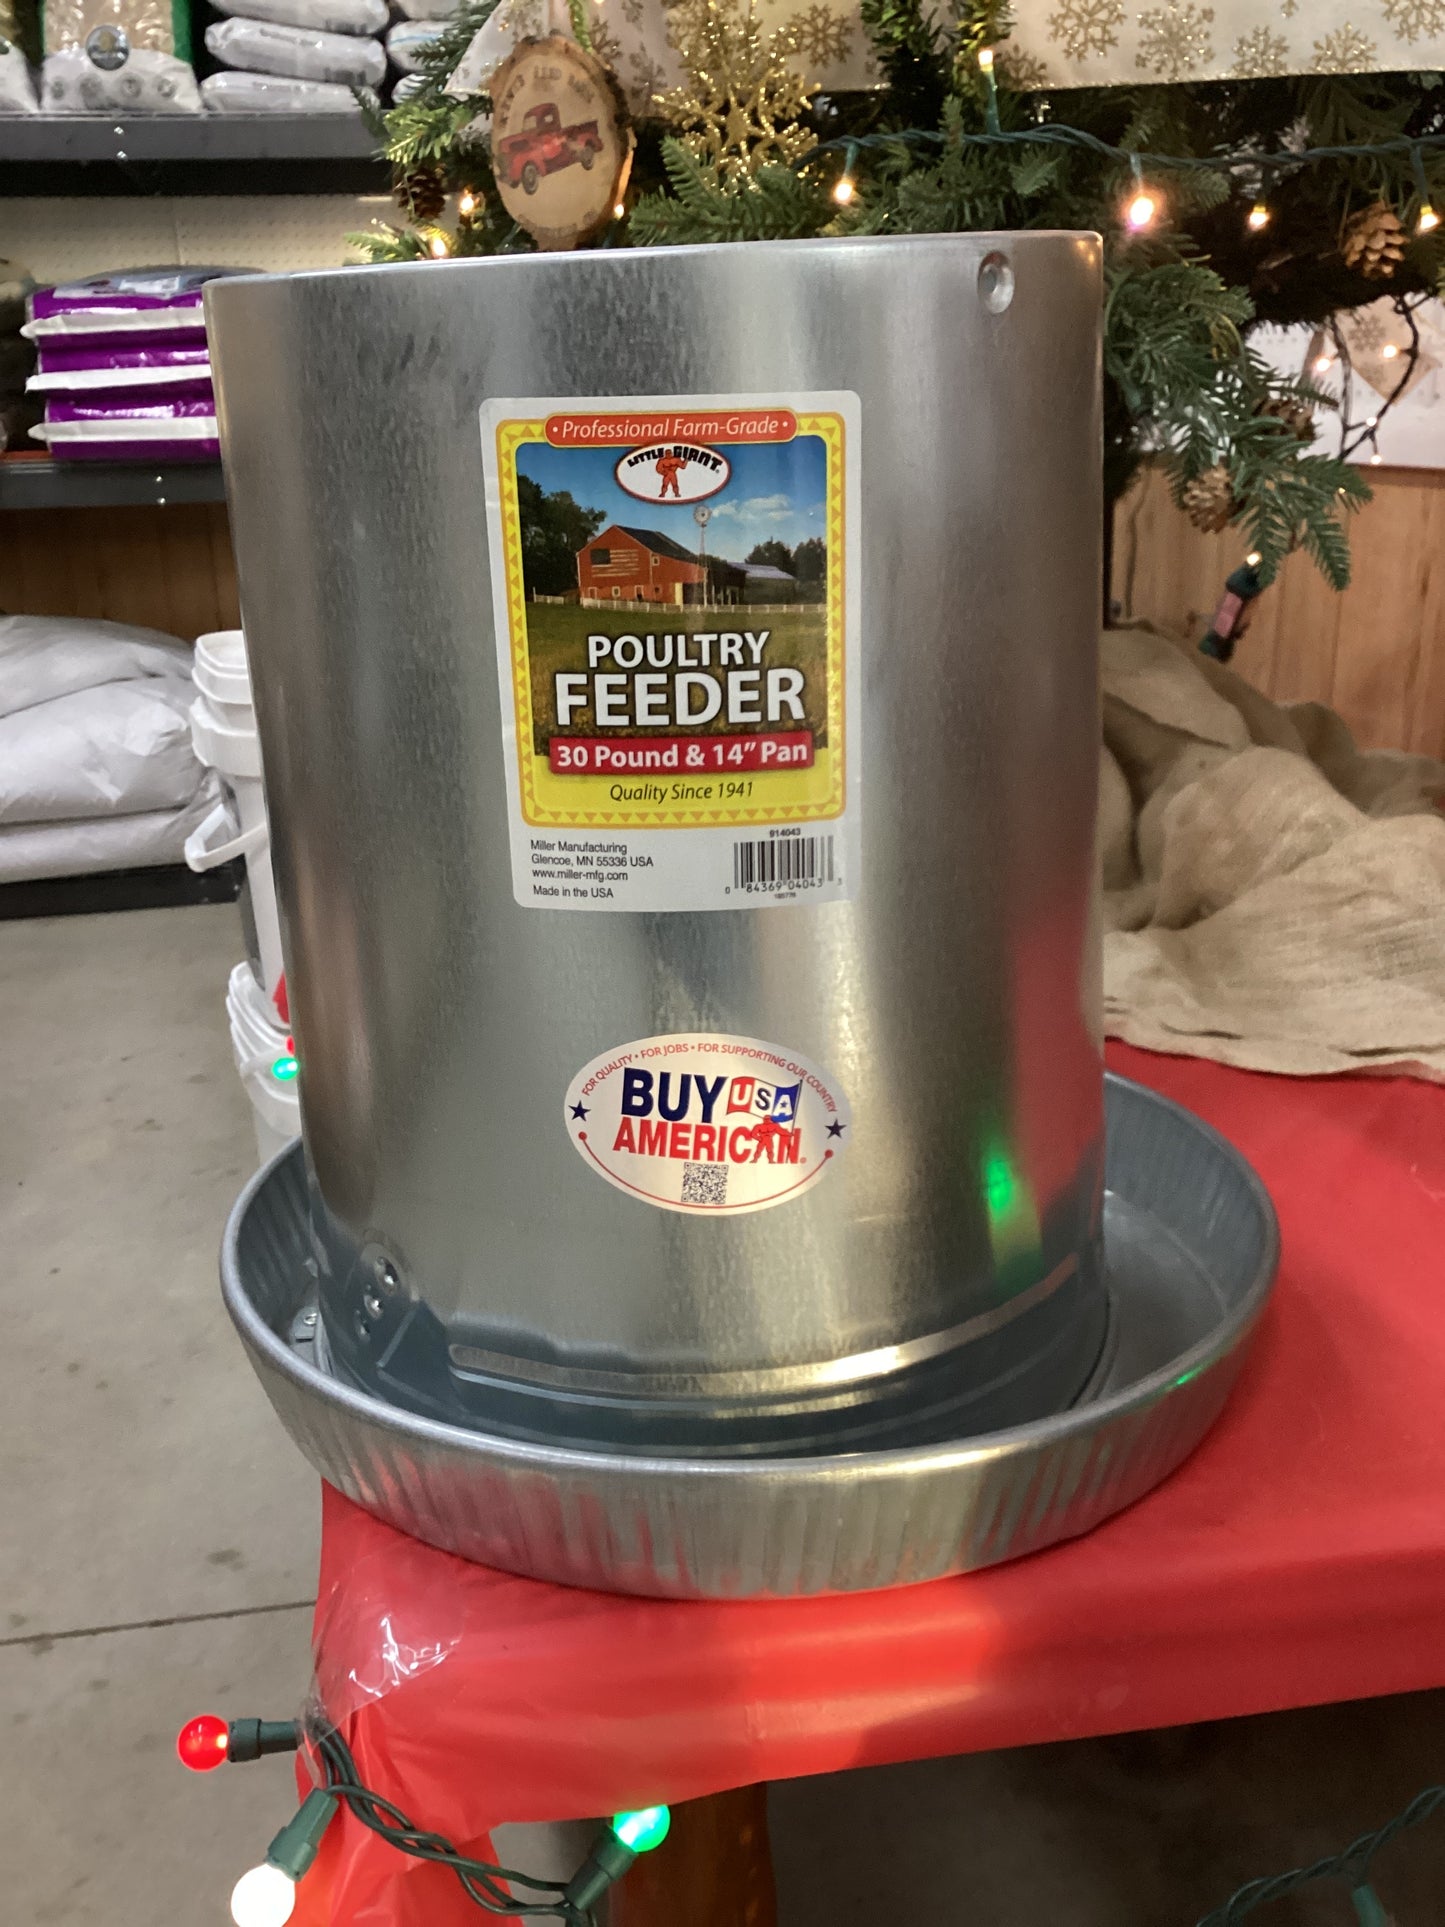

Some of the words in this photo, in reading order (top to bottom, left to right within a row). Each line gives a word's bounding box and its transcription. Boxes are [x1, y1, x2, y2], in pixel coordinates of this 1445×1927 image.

[562, 419, 668, 438] Professional
[673, 415, 779, 436] Farm-Grade
[627, 447, 665, 468] LITTLE
[673, 445, 723, 473] GIANT
[587, 631, 770, 668] POULTRY
[555, 668, 806, 727] FEEDER
[557, 745, 588, 767] 30
[595, 744, 678, 768] Pound
[685, 745, 705, 766] &
[761, 740, 808, 763] Pan
[610, 783, 668, 804] Quality
[671, 783, 712, 799] Since
[718, 781, 754, 798] 1941
[530, 839, 556, 851] Miller
[558, 840, 628, 855] Manufacturing
[531, 853, 574, 867] Glencoe,
[576, 855, 594, 866] MN
[596, 855, 628, 867] 55336
[629, 856, 654, 867] USA
[532, 868, 628, 883] www.miller-mfg.com
[746, 881, 782, 893] 84369
[533, 884, 560, 897] Made
[562, 886, 571, 897] in
[573, 886, 589, 898] the
[591, 887, 615, 899] USA
[581, 1078, 600, 1097] FOR
[595, 1053, 633, 1081] QUALITY
[640, 1046, 662, 1059] FOR
[663, 1043, 689, 1057] JOBS
[697, 1043, 719, 1053] FOR
[721, 1044, 787, 1068] SUPPORTING
[786, 1062, 808, 1079] OUR
[806, 1075, 838, 1113] COUNTRY
[621, 1067, 729, 1124] BUY
[729, 1083, 795, 1117] USA
